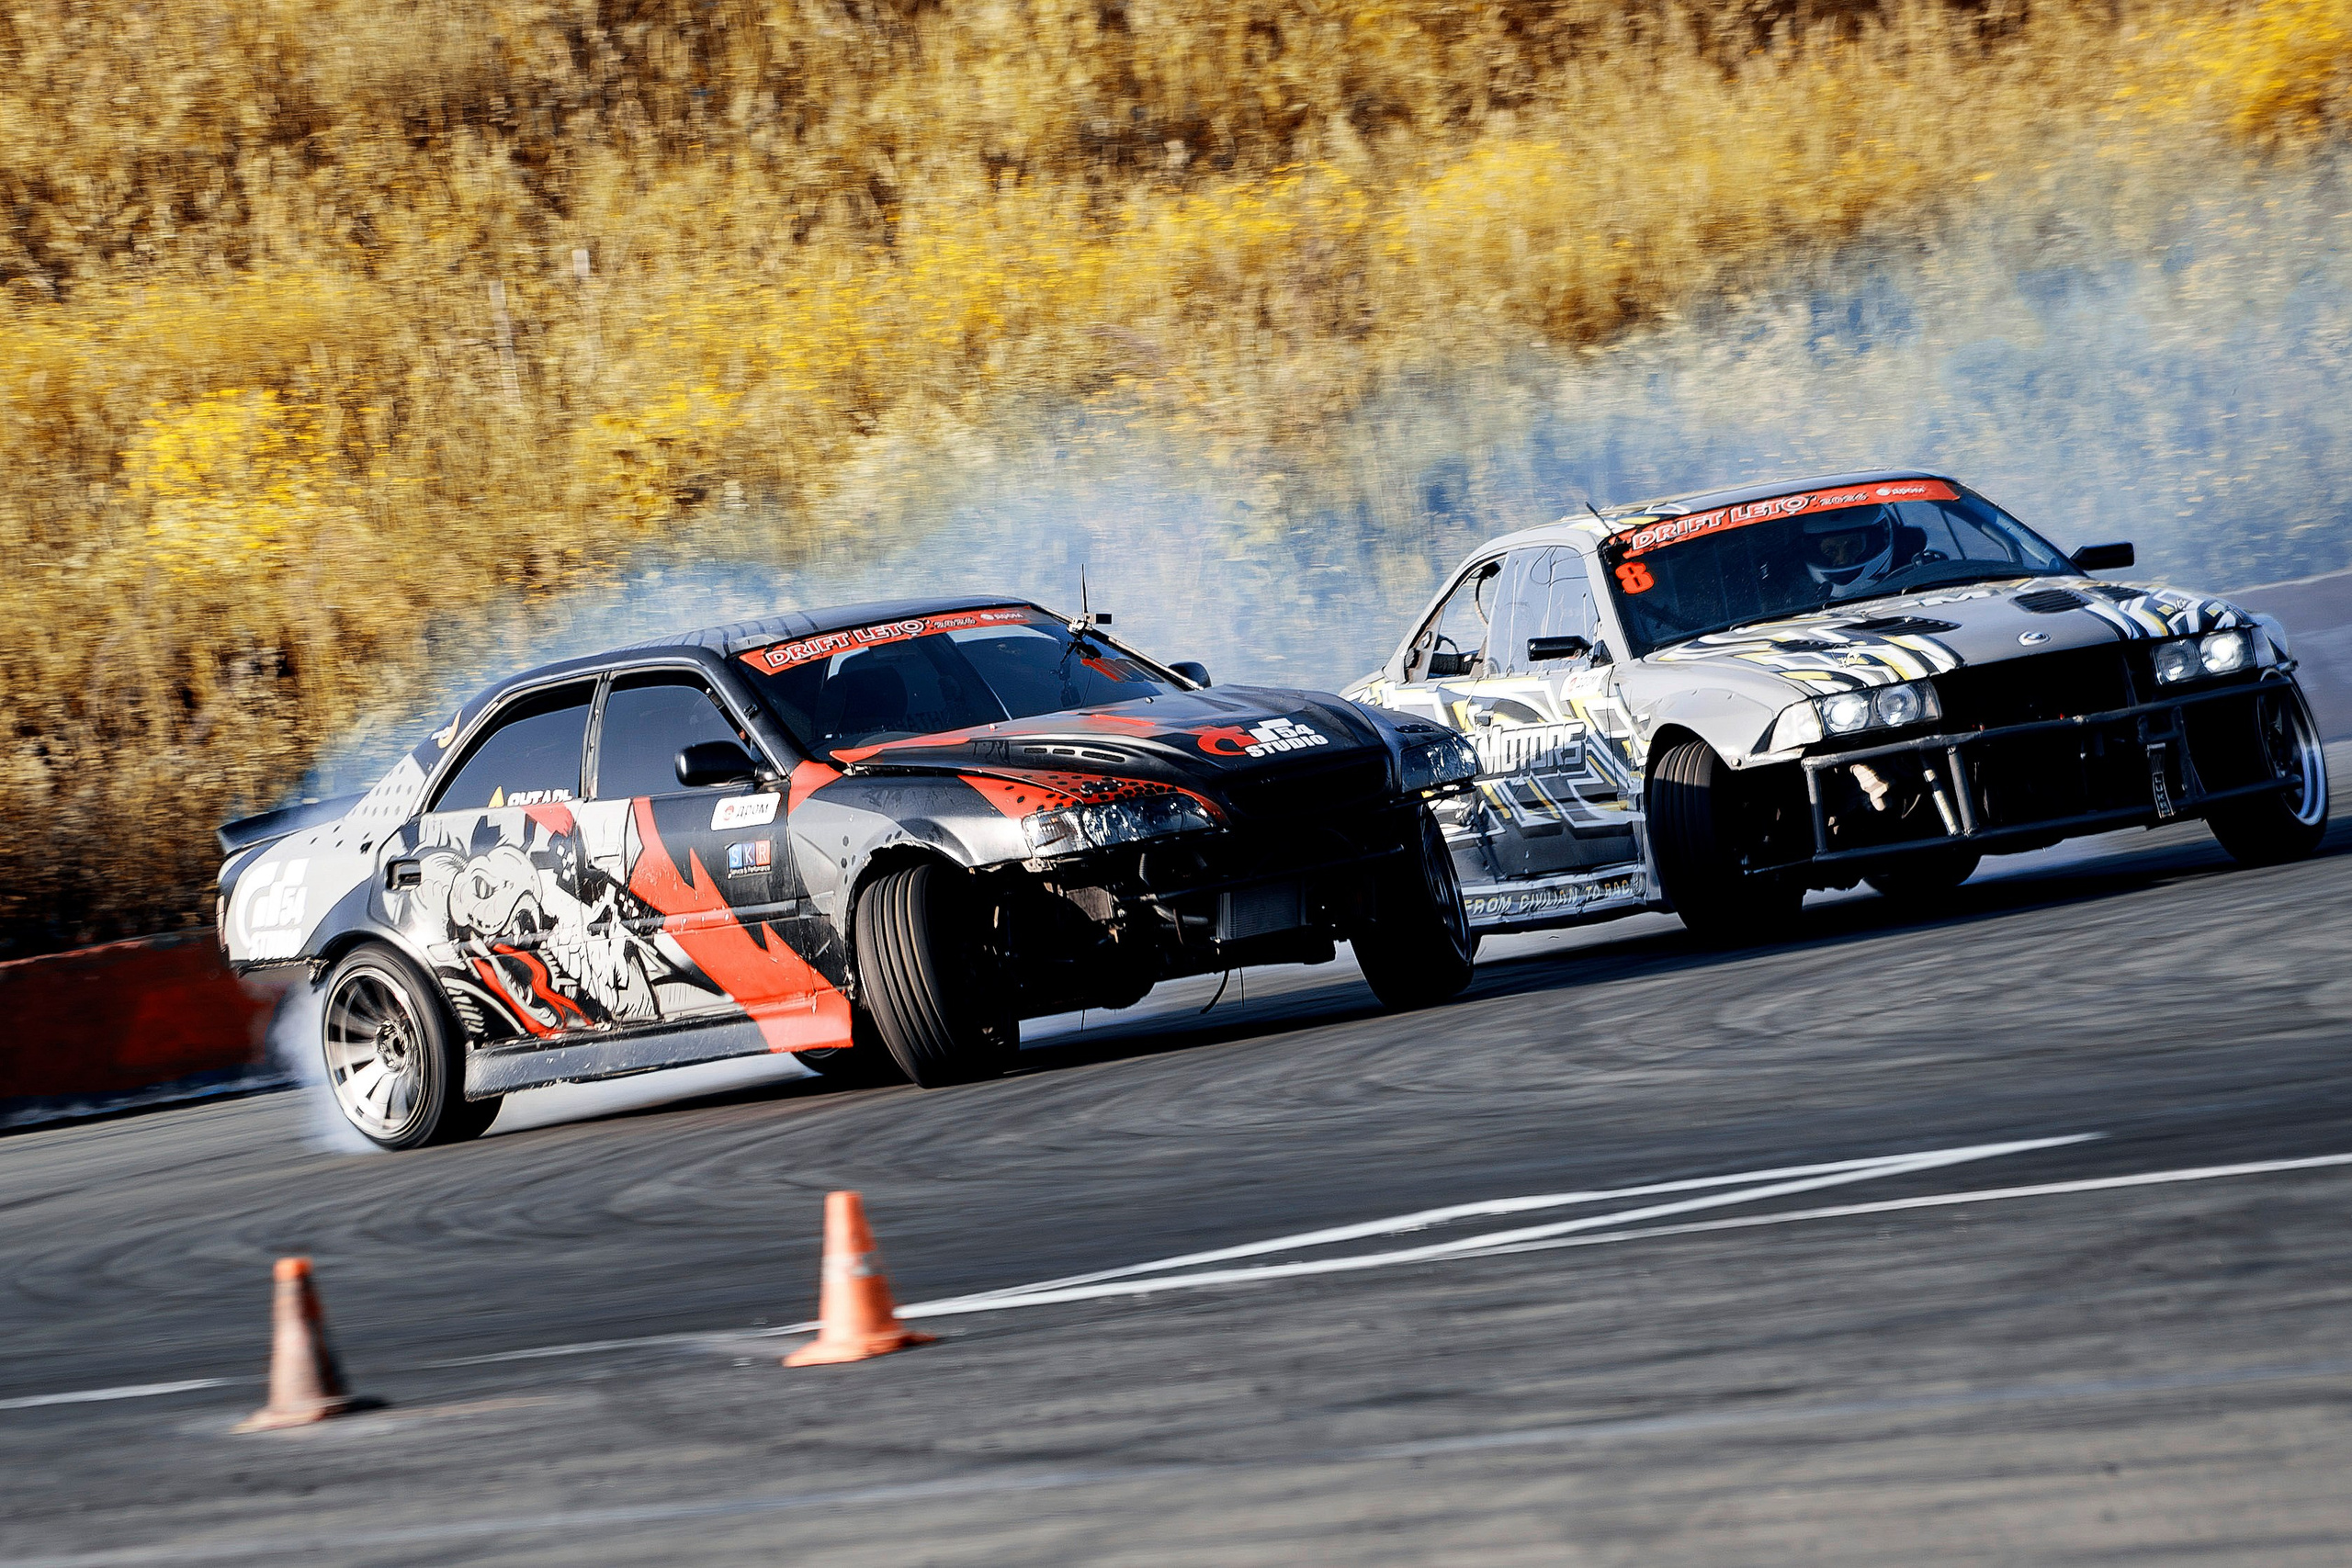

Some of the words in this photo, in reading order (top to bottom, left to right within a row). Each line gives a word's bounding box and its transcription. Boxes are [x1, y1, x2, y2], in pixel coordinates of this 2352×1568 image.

[1632, 509, 1726, 551] DRIFT
[1615, 560, 1655, 595] 8
[764, 631, 850, 668] DRIFT
[1244, 734, 1329, 759] STUDIO
[730, 841, 770, 866] SKR
[1464, 896, 1512, 916] FROM
